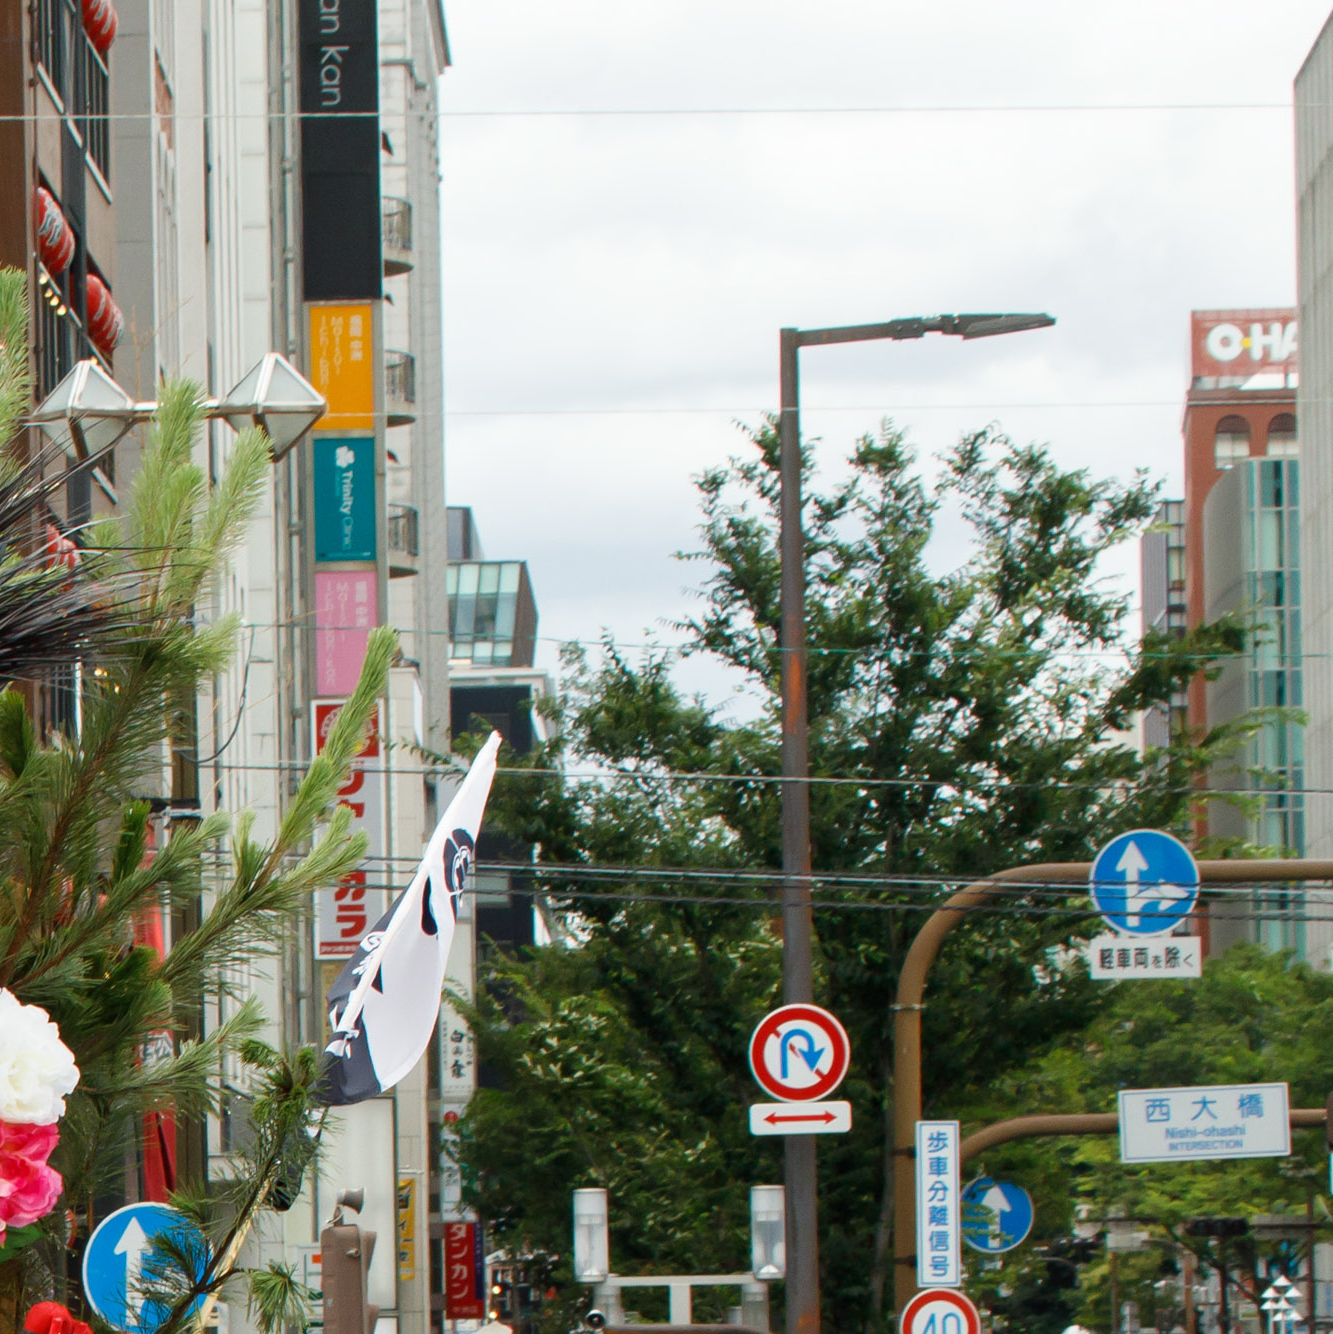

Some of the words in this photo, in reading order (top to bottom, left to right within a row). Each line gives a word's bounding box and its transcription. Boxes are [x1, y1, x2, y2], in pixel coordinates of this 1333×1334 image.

[320, 45, 349, 106] kan
[1099, 946, 1193, 970] 軽車両を除く
[1144, 1093, 1264, 1123] 西大橋
[1165, 1124, 1246, 1140] Nishi-ohashi
[1168, 1139, 1244, 1152] INTERSECTION
[927, 1130, 950, 1278] 歩車分離信号
